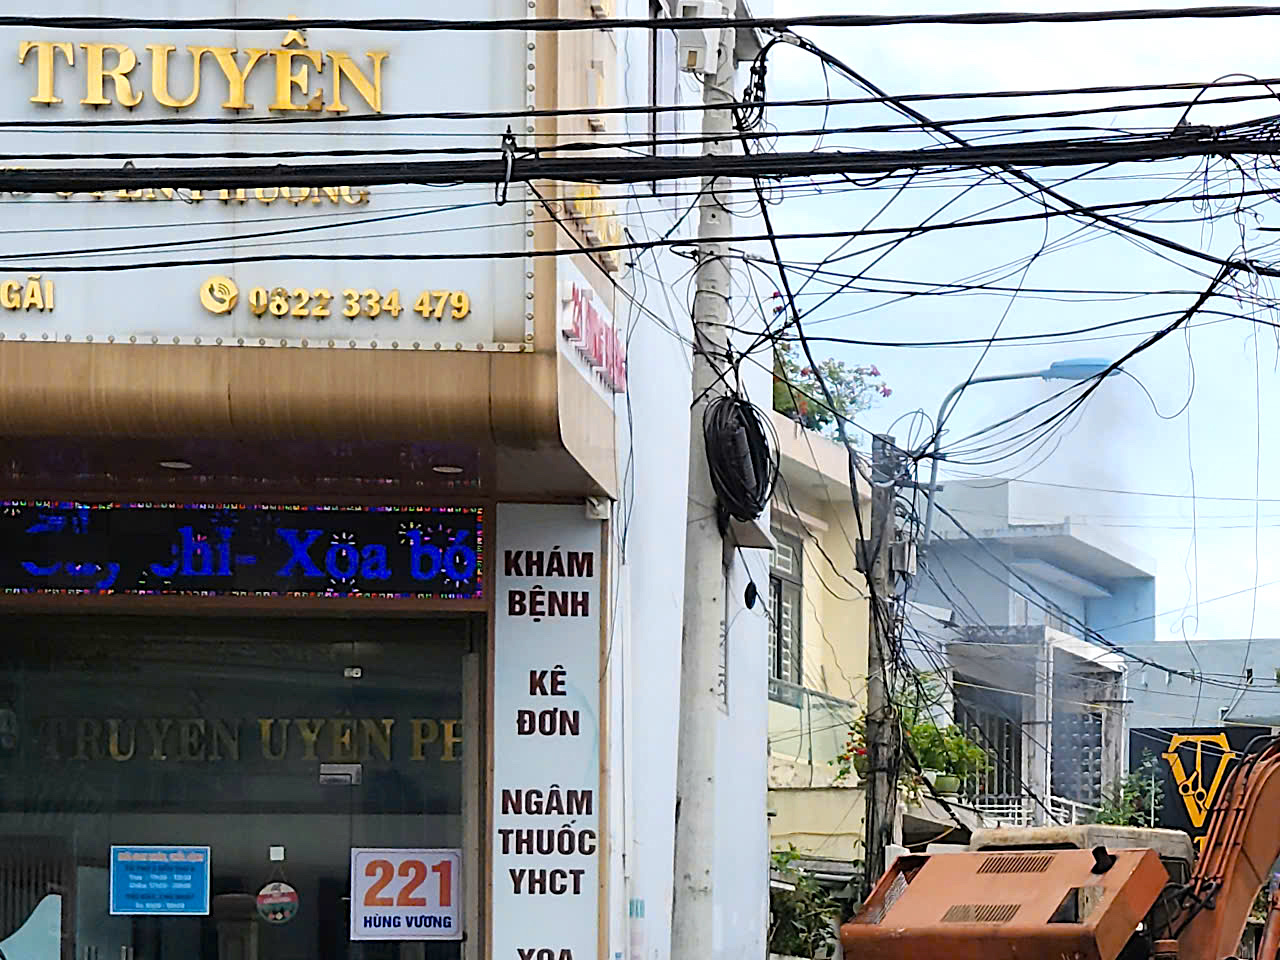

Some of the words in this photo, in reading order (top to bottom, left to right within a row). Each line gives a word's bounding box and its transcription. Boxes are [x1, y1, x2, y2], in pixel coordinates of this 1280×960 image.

[248, 286, 331, 318] 0822
[342, 288, 401, 319] 334
[413, 289, 470, 319] 479
[504, 545, 594, 578] KHÁM
[508, 585, 589, 622] BỆNH
[529, 665, 567, 696] KÊ
[516, 707, 580, 736] ĐƠN
[501, 784, 593, 815] NGÂM
[498, 820, 597, 855] THUỐC
[363, 859, 452, 907] 221
[509, 869, 585, 895] YHCT
[363, 913, 402, 928] HÙNG
[405, 914, 452, 928] VƯƠNG
